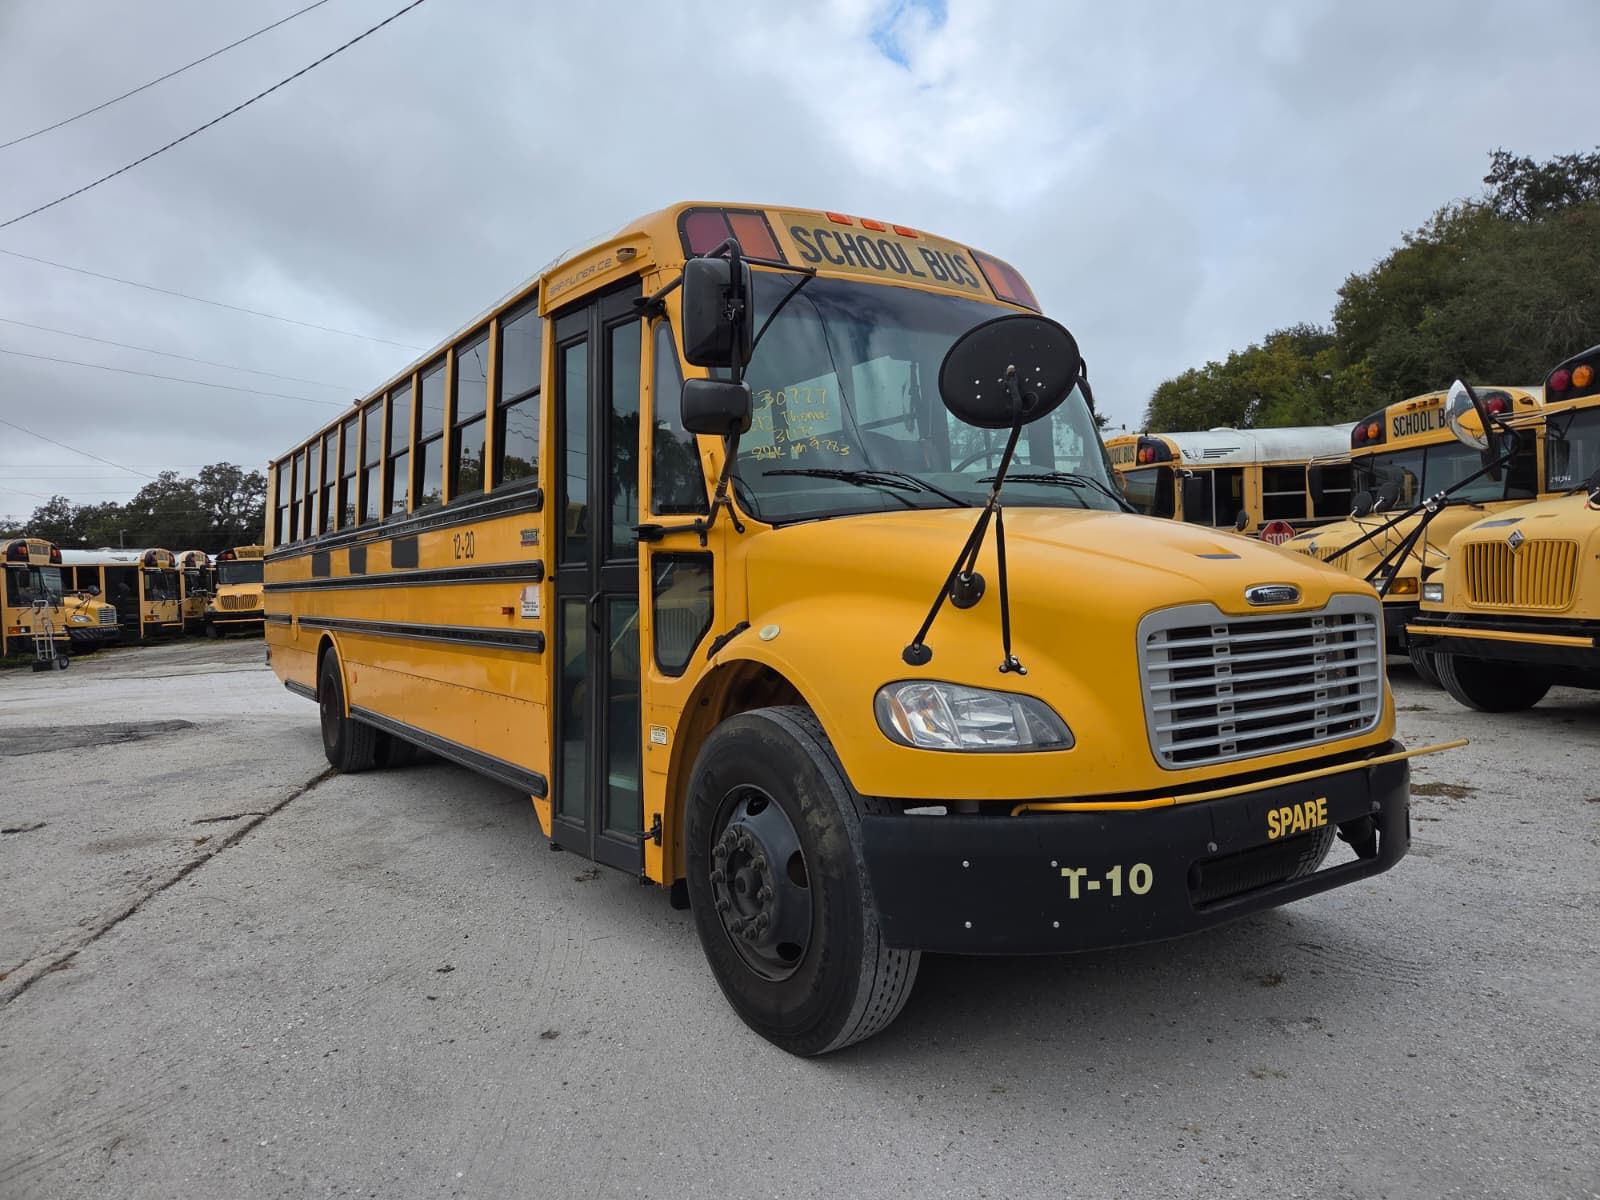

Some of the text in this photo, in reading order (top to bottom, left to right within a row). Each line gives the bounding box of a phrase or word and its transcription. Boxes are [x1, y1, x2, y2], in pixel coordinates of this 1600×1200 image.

[790, 226, 981, 289] SCHOOL BUS
[1393, 410, 1434, 438] SCHOOL
[1267, 797, 1328, 840] SPARE
[1060, 863, 1154, 900] T-10
